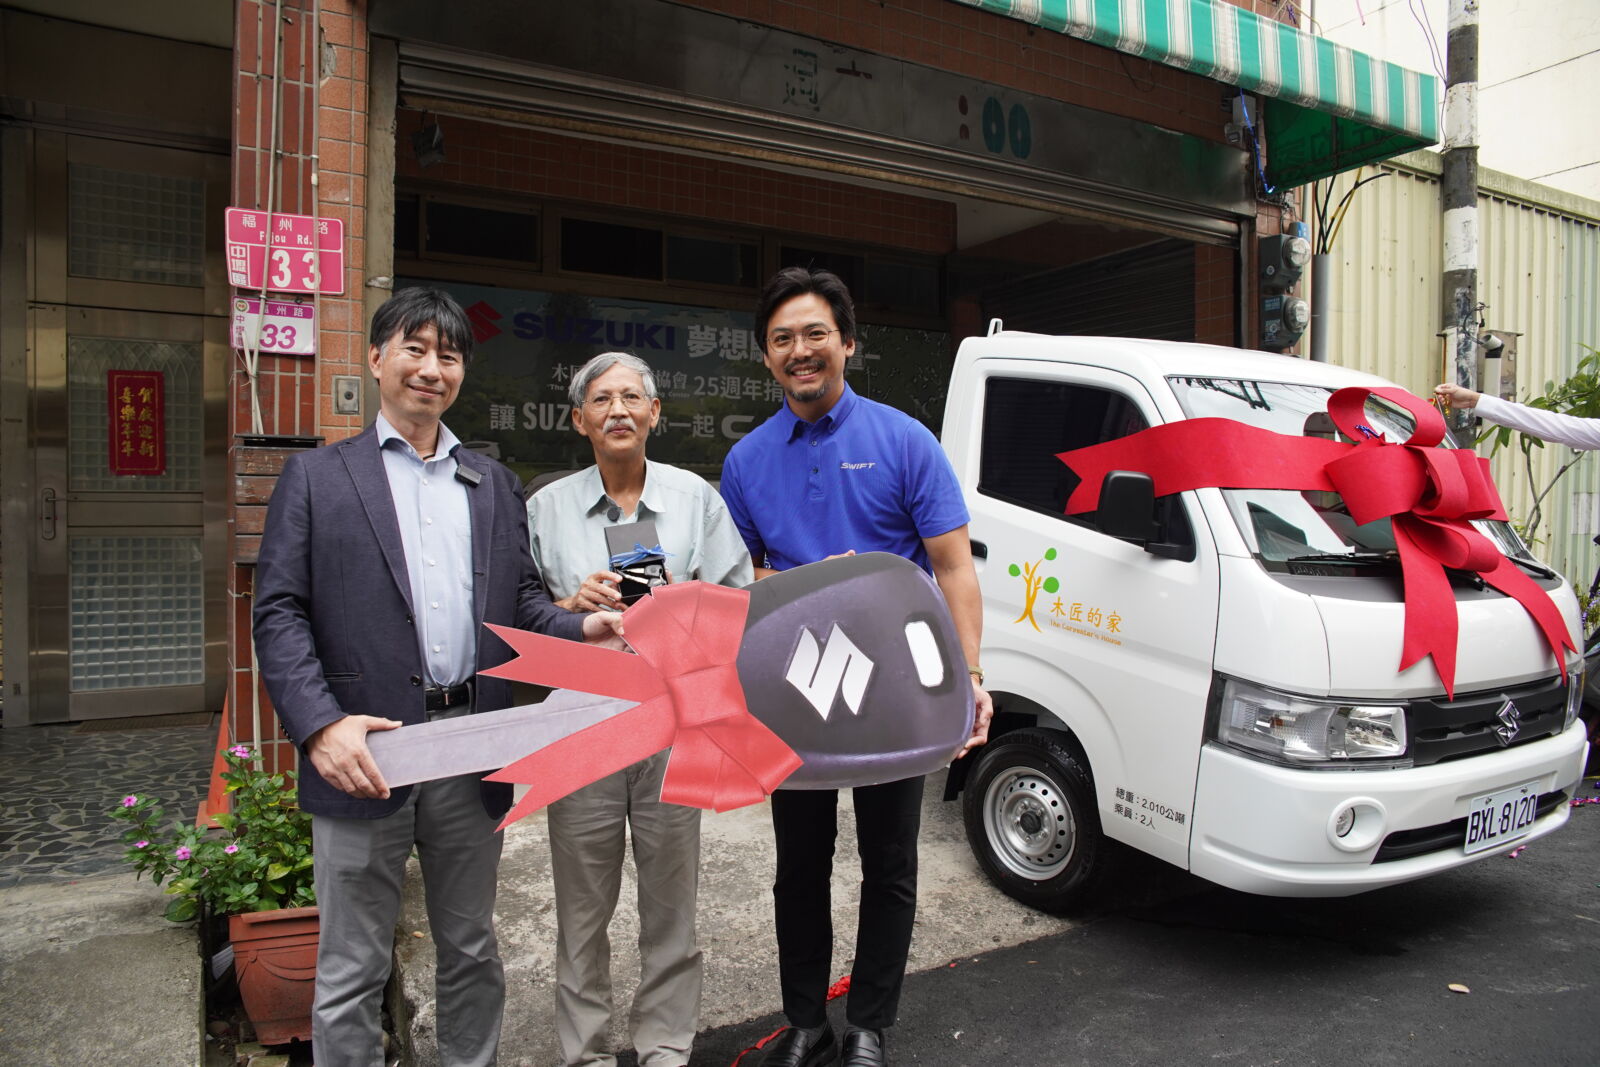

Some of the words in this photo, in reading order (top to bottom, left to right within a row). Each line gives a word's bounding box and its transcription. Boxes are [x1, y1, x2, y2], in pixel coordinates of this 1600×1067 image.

[260, 231, 286, 243] Fjou
[297, 235, 312, 245] Rd.
[272, 250, 321, 289] 33
[259, 324, 297, 349] 33
[513, 312, 675, 350] SUZUKI
[489, 404, 516, 431] 讓
[840, 462, 876, 470] SWIFT
[1050, 596, 1122, 633] 木匠的家
[1467, 794, 1537, 845] BXL-8120
